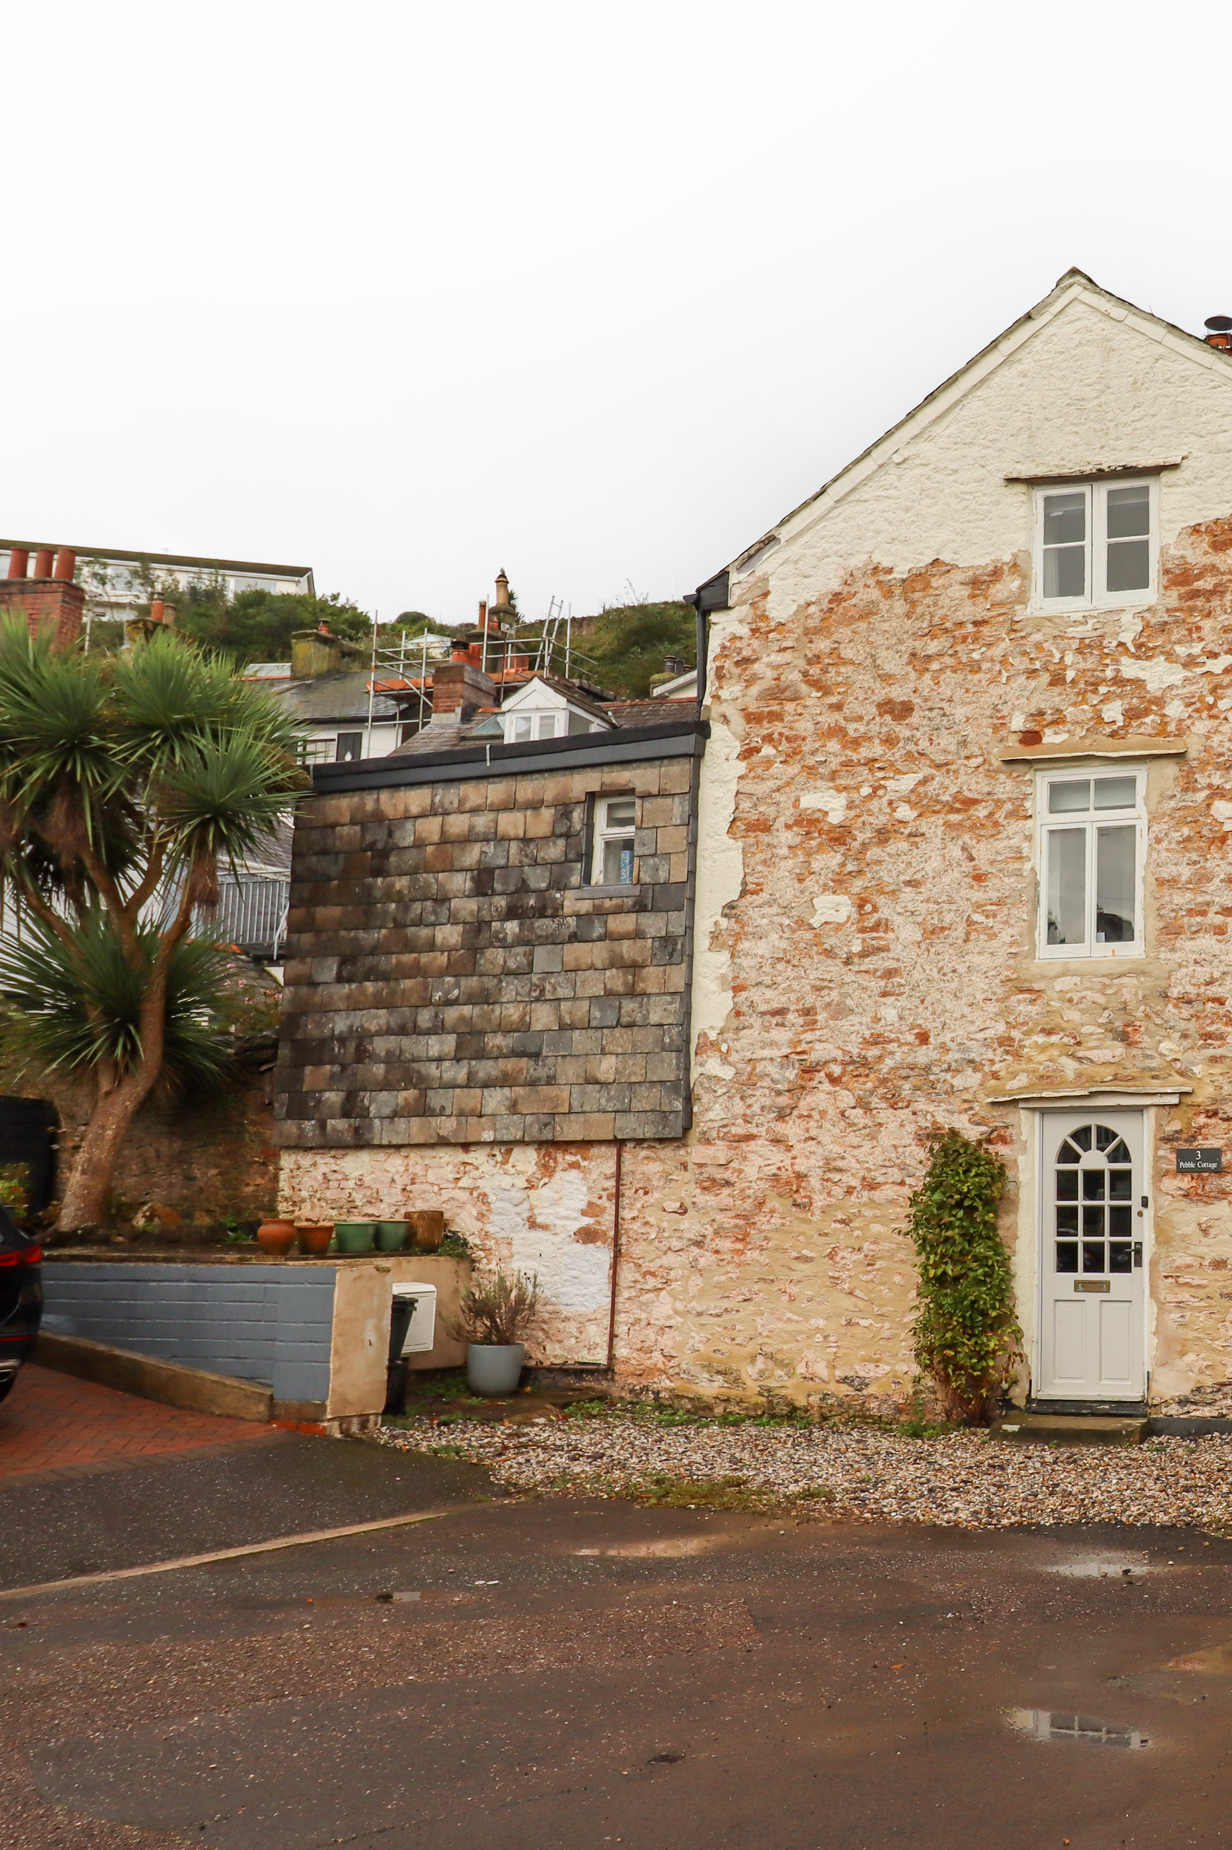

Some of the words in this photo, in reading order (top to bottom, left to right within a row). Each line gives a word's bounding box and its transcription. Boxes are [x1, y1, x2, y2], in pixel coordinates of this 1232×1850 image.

[1195, 1150, 1201, 1160] 3
[1179, 1161, 1196, 1169] Pebble
[1197, 1161, 1218, 1170] Cottage
